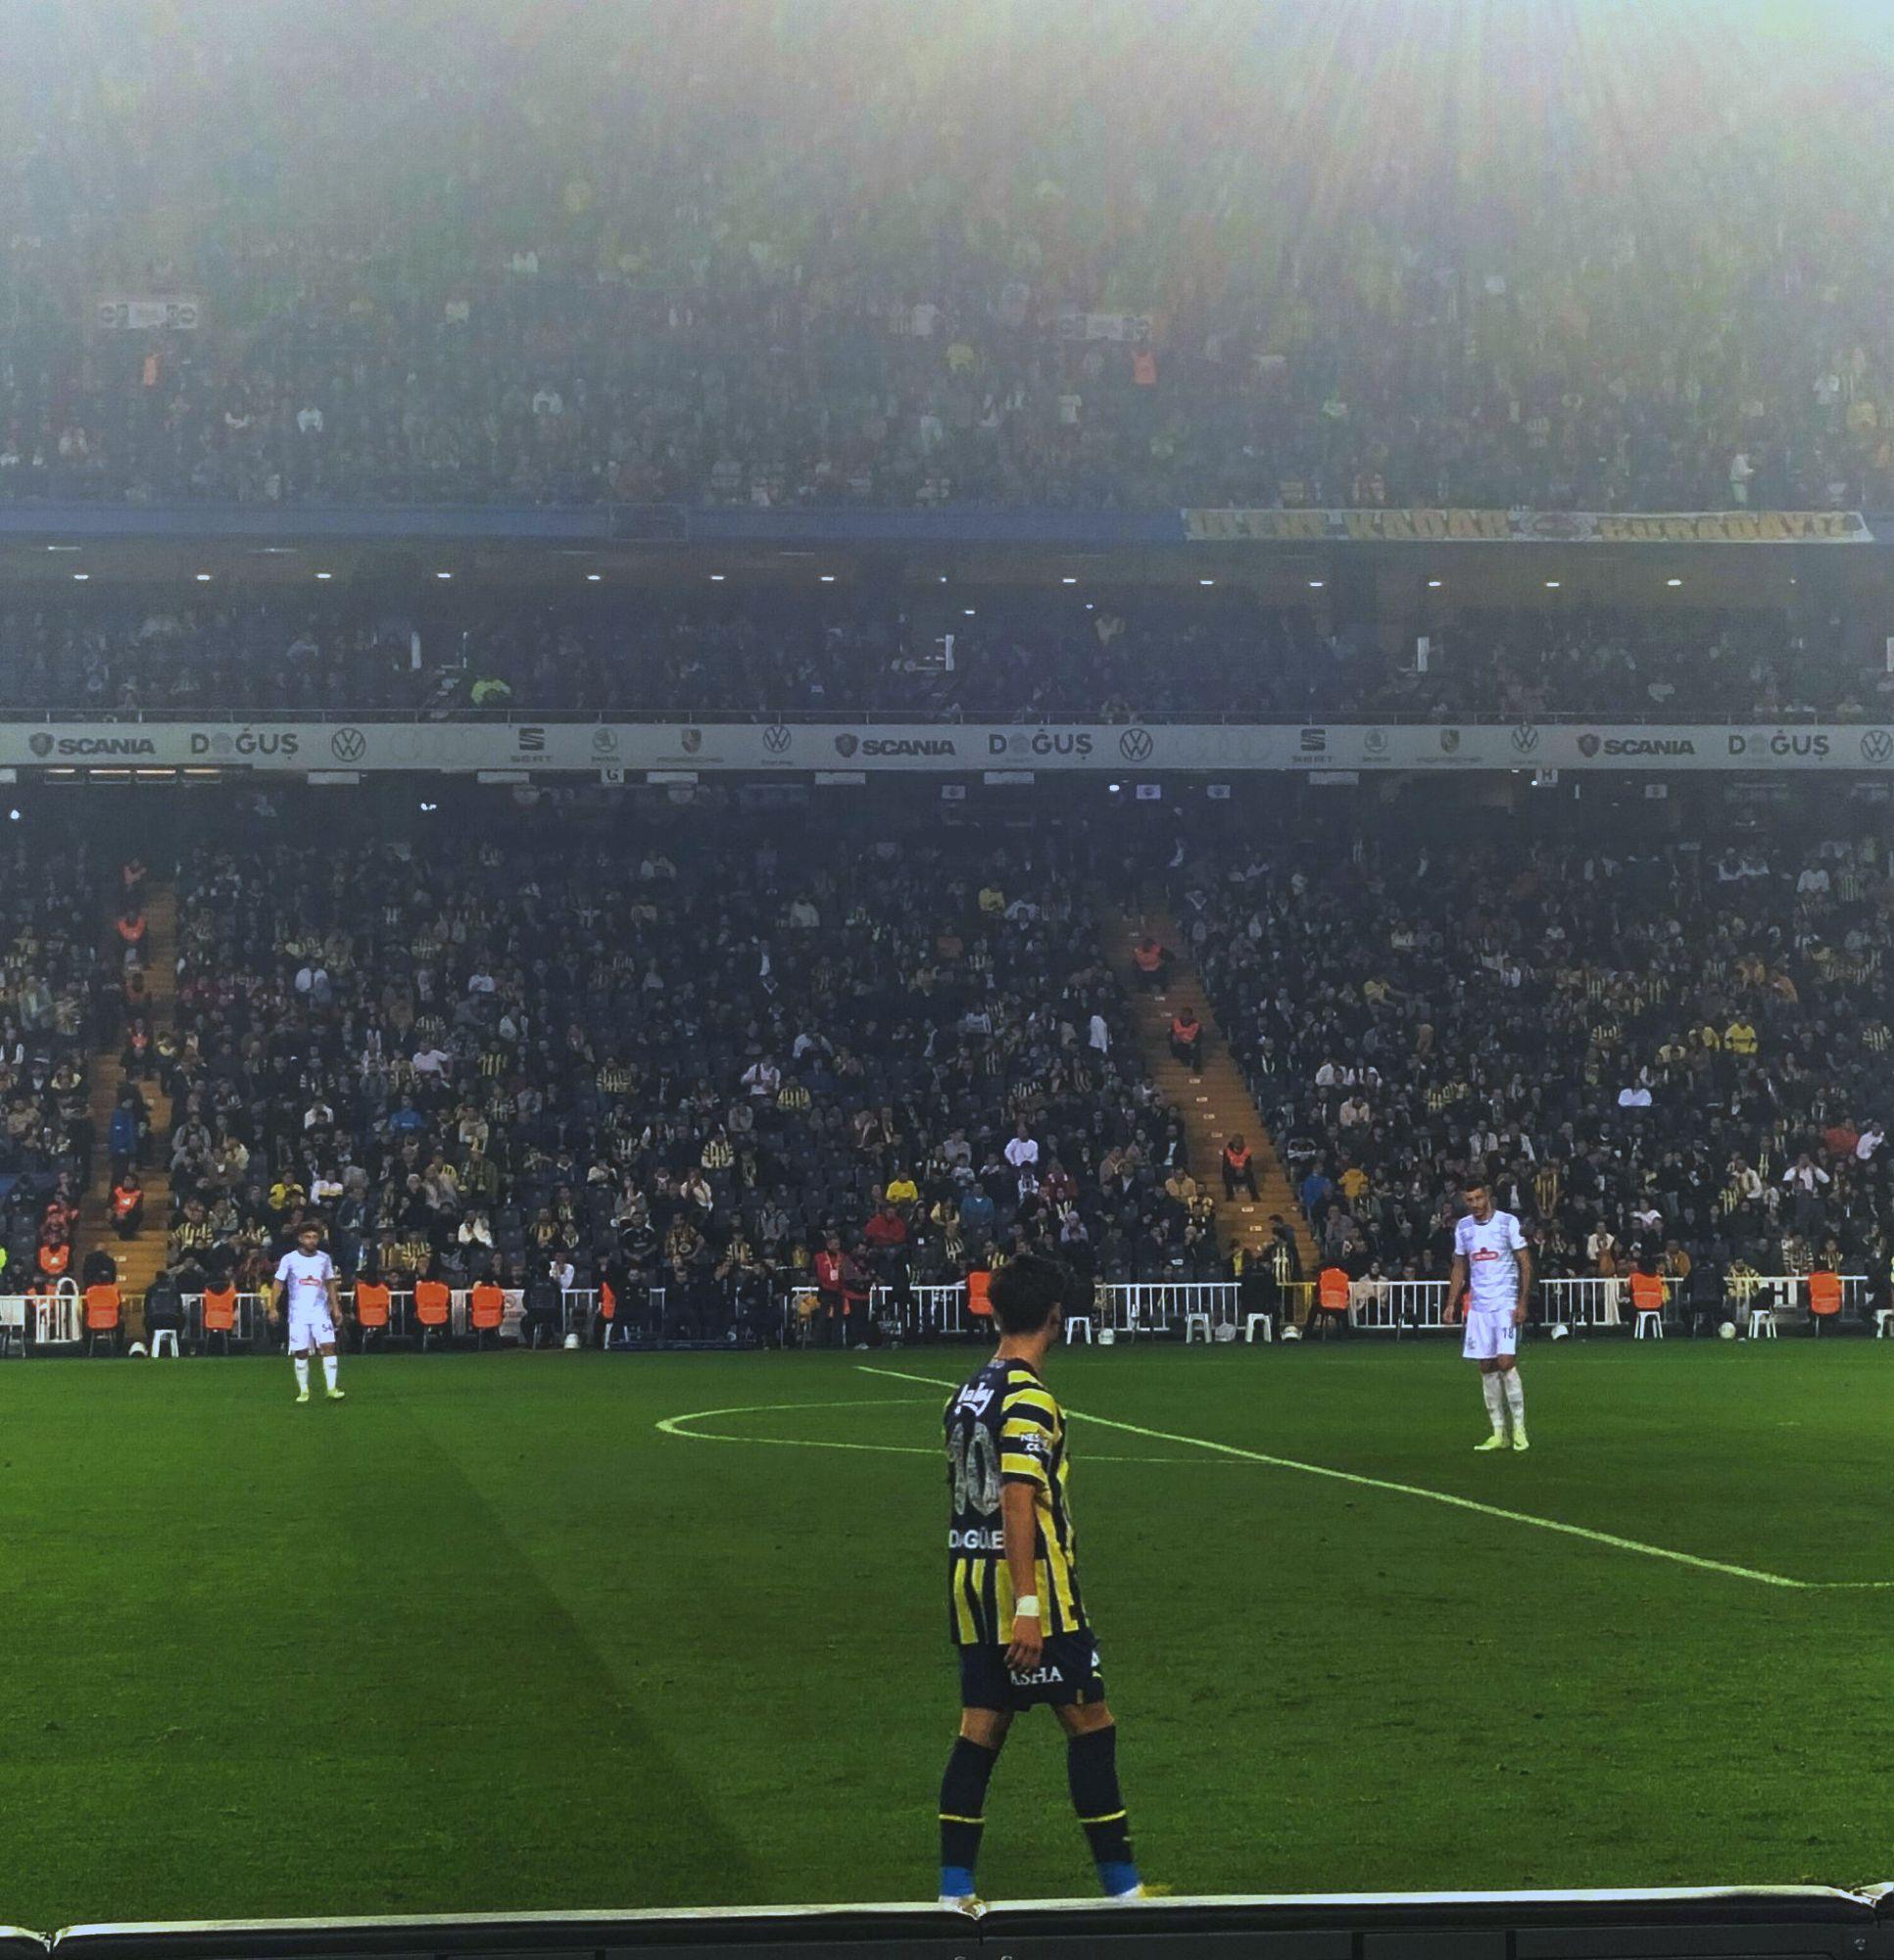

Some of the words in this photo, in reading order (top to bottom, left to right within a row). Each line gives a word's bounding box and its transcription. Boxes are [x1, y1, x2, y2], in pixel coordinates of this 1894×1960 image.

[58, 738, 156, 756] SCANIA
[861, 739, 956, 757] SCANIA
[1604, 740, 1695, 755] SCANIA
[1010, 1666, 1064, 1686] ASHA
